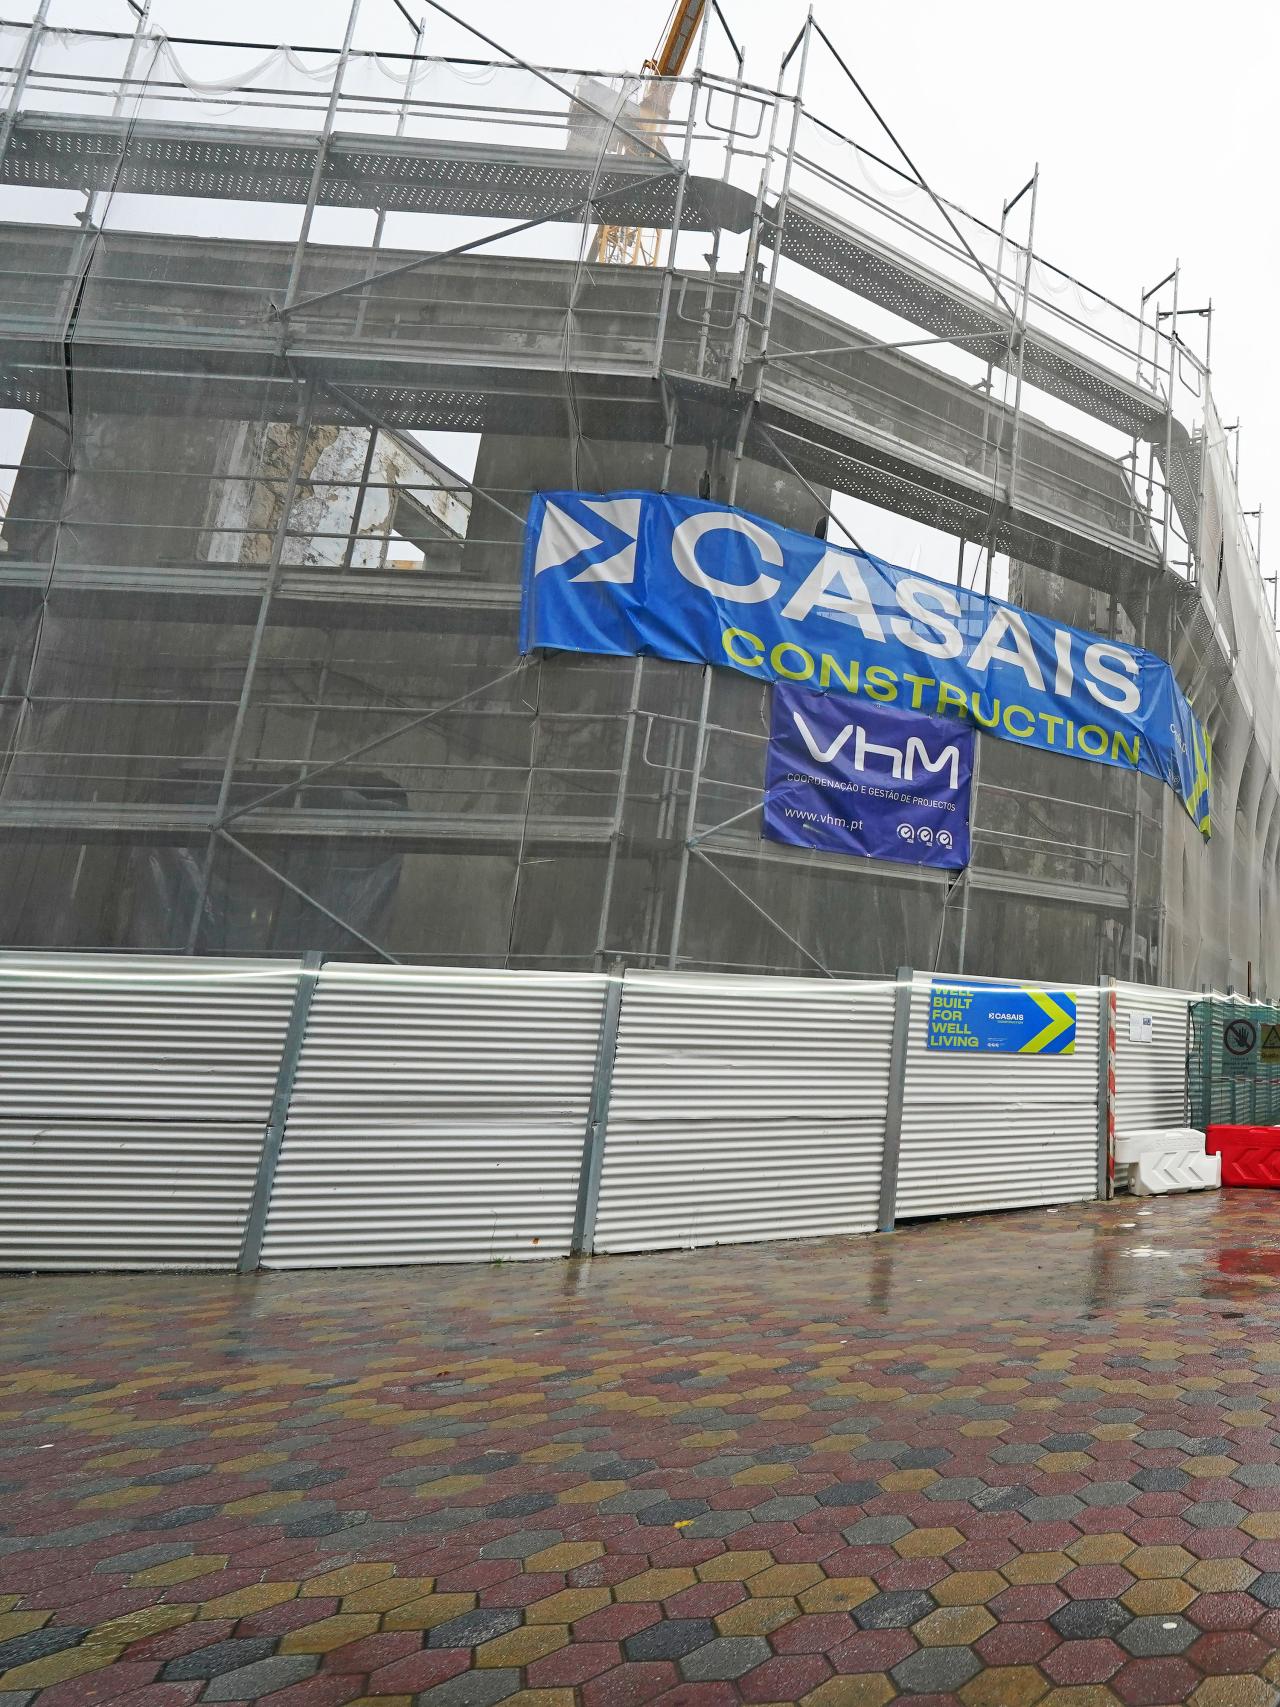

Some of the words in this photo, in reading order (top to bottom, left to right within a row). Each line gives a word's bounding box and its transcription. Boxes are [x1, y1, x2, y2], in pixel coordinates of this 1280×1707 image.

[671, 511, 1141, 714] CASAIS
[721, 627, 1140, 764] CONSTRUCTION
[787, 772, 859, 792] COORDENAÇÃO
[860, 785, 867, 794] E
[868, 787, 900, 801] GESTÃO
[900, 793, 911, 804] DE
[912, 797, 956, 812] PROJECTOS
[784, 808, 864, 832] www.vhm.pt
[932, 996, 973, 1010] BUILT
[931, 1010, 963, 1022] FOR
[994, 1012, 1024, 1021] CASAIS
[931, 1022, 972, 1035] WELL
[930, 1036, 979, 1048] LIVING
